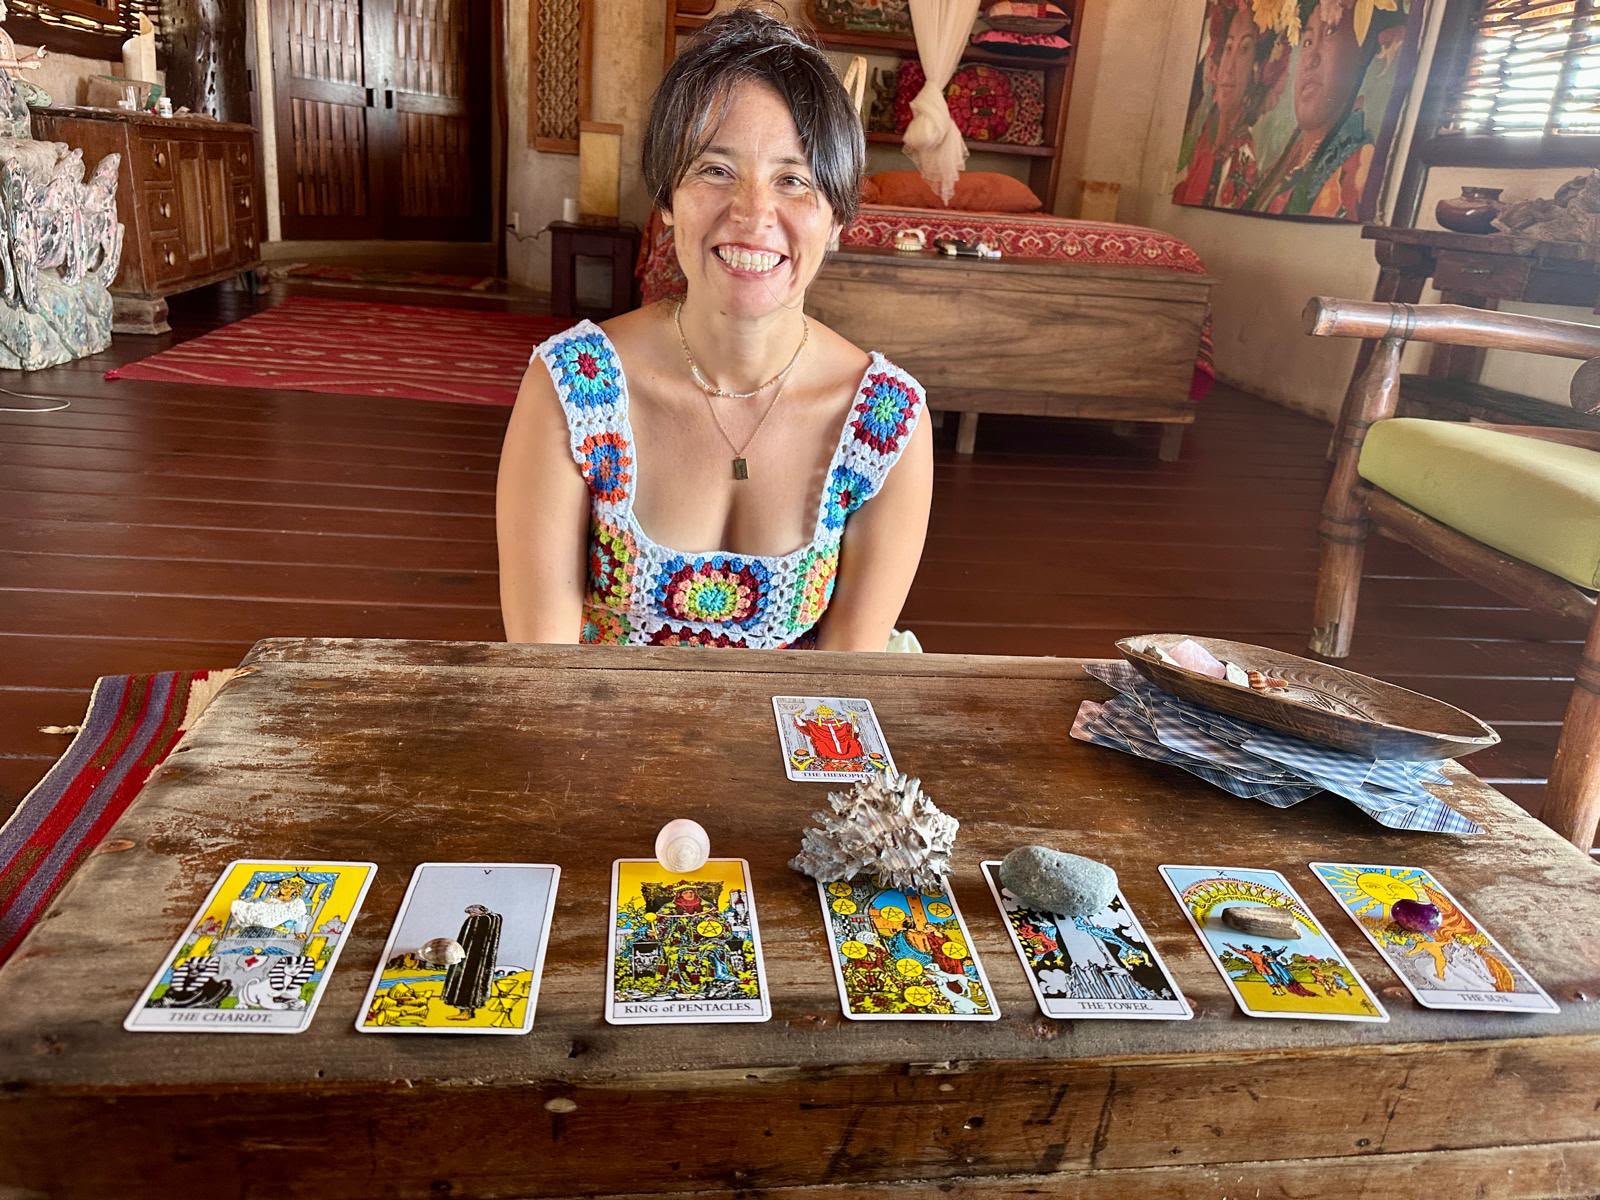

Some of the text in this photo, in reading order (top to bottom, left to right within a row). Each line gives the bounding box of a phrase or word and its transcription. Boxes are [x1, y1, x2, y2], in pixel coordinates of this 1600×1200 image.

[823, 772, 875, 780] HIEROPHA
[1457, 993, 1484, 1001] THE
[625, 1002, 755, 1014] KING of PENTACLES.
[1077, 1001, 1105, 1010] THE
[169, 1012, 273, 1023] THE CHARIOT.
